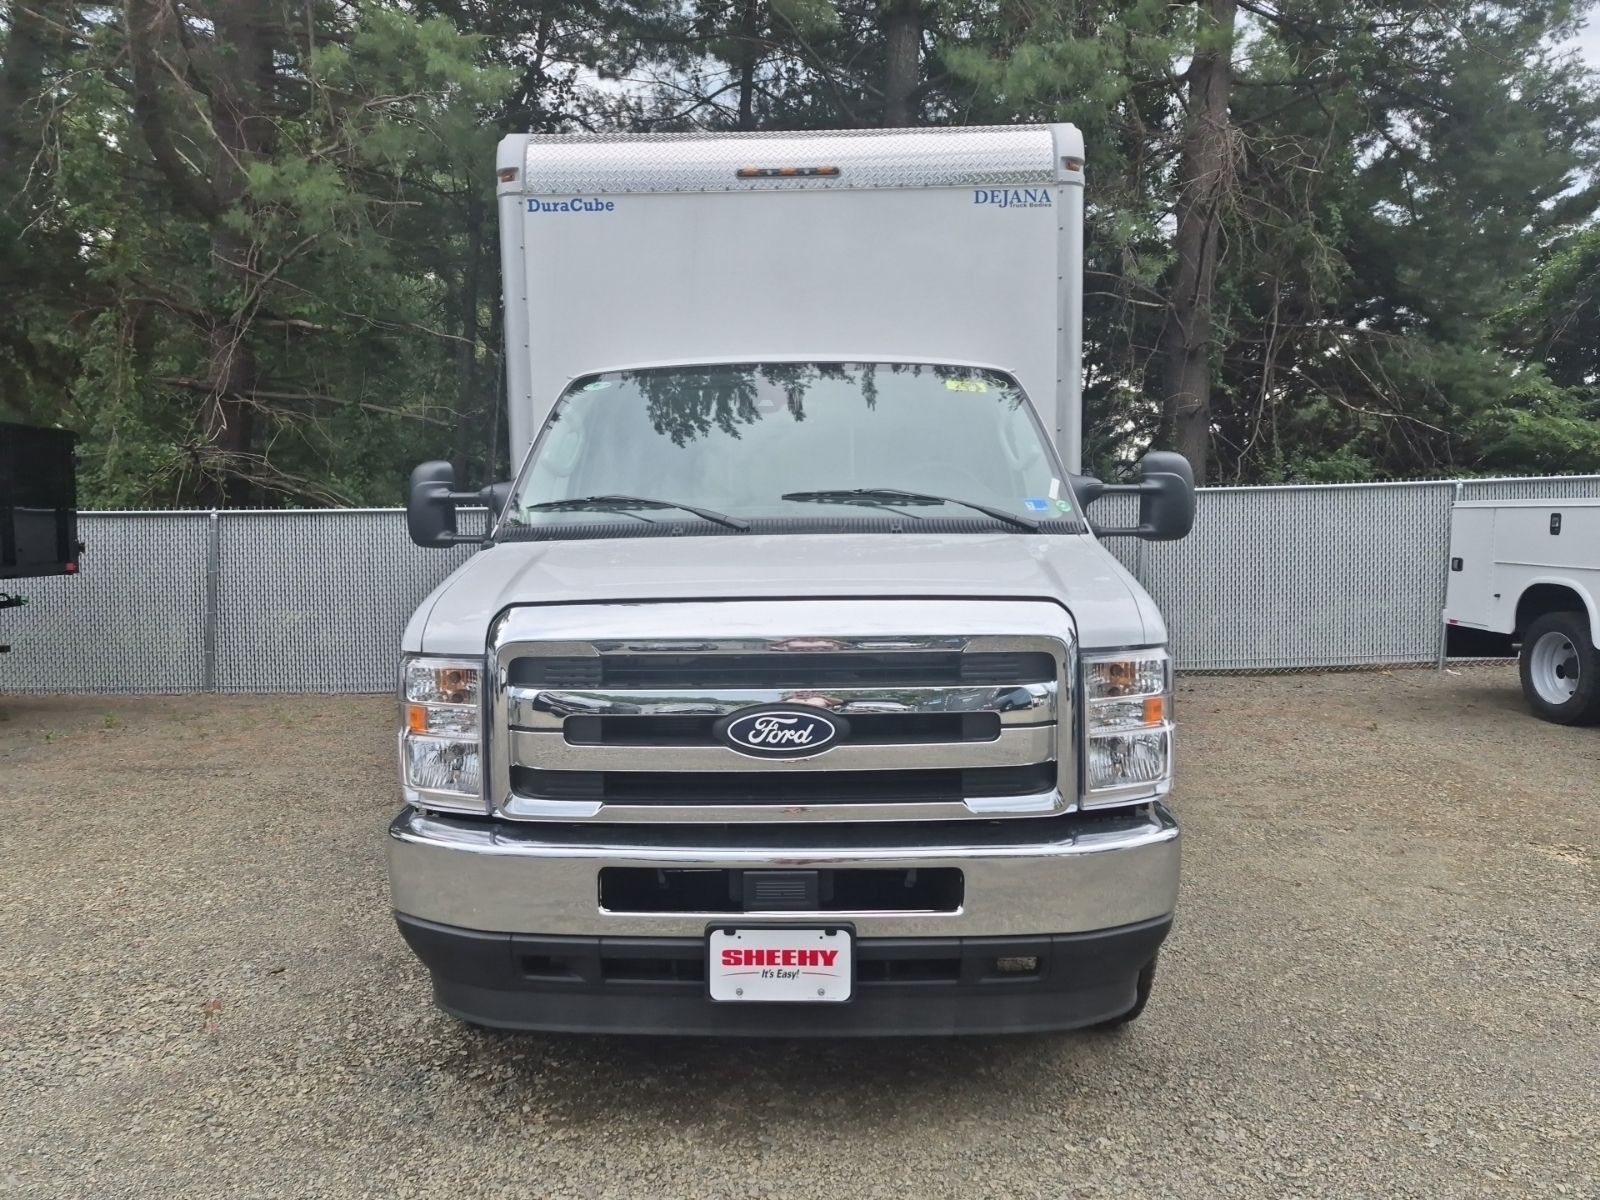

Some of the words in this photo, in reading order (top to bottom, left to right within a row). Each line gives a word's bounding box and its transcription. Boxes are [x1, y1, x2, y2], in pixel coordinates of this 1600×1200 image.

[527, 198, 615, 213] DuraCube
[974, 188, 1052, 208] DEJANA
[748, 716, 815, 744] Ford
[721, 949, 839, 967] SHEEHY
[761, 969, 774, 979] It's
[776, 969, 800, 980] Easy!
